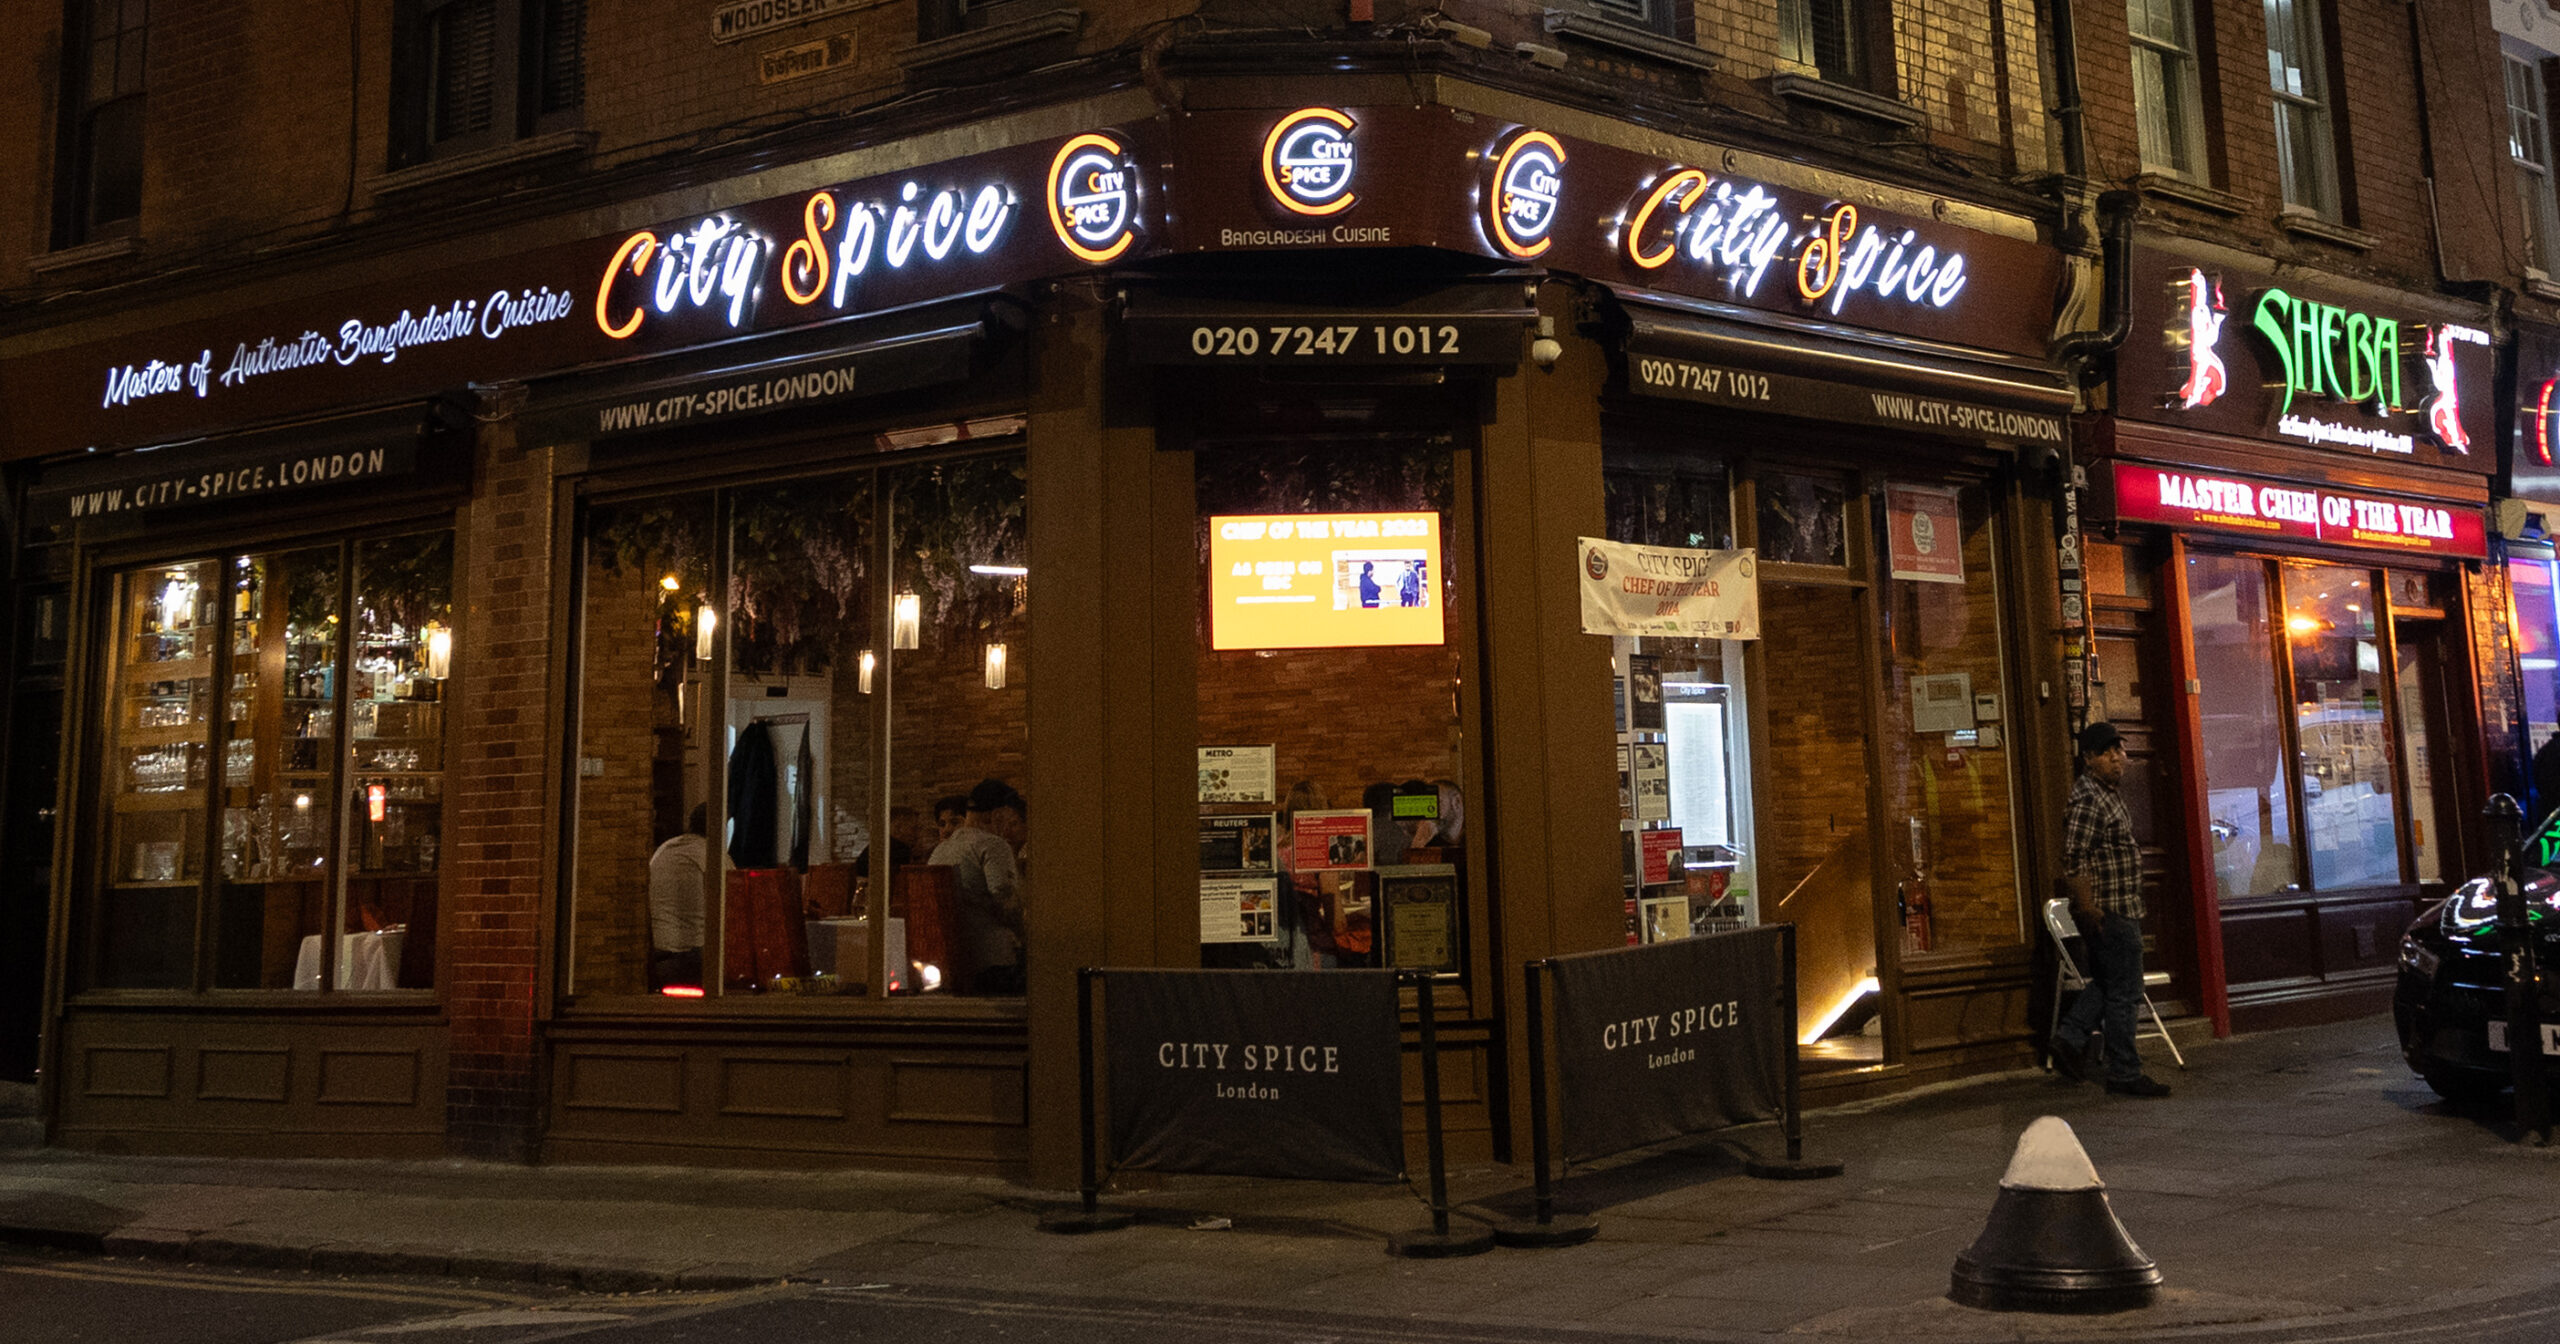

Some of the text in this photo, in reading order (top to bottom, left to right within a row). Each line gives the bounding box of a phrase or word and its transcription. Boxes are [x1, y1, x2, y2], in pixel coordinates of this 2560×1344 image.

[596, 181, 1010, 338] City Spice
[1629, 169, 1966, 315] City Spice
[103, 286, 574, 408] Masters of Authentic Bangladeshi Cuisine
[1192, 325, 1459, 356] 020 7247 1012
[2254, 288, 2401, 414] SHEBA
[599, 367, 856, 433] WWW.CITY-SPICE.LONDON
[1640, 359, 1770, 400] 020 7247 1012
[1872, 393, 2062, 442] WWW.CITY-SPICE.LONDON
[71, 448, 385, 517] WWW.CITY-SPICE.LONDON
[2158, 473, 2454, 540] MASTER CHEF OF THE YEAR
[1221, 522, 1267, 540] CHEF
[1268, 521, 1294, 539] OF
[1296, 520, 1329, 538] THE
[1332, 519, 1379, 538] YEAR
[1637, 552, 1669, 577] CITY
[1623, 576, 1655, 596] CHEF
[1656, 581, 1671, 596] OF
[1205, 749, 1234, 758] METRO
[1214, 818, 1249, 829] REUTERS
[1603, 1000, 1739, 1051] CITY SPICE
[1159, 1043, 1340, 1073] CITY SPICE
[1648, 1047, 1695, 1069] London
[1216, 1082, 1280, 1099] London
